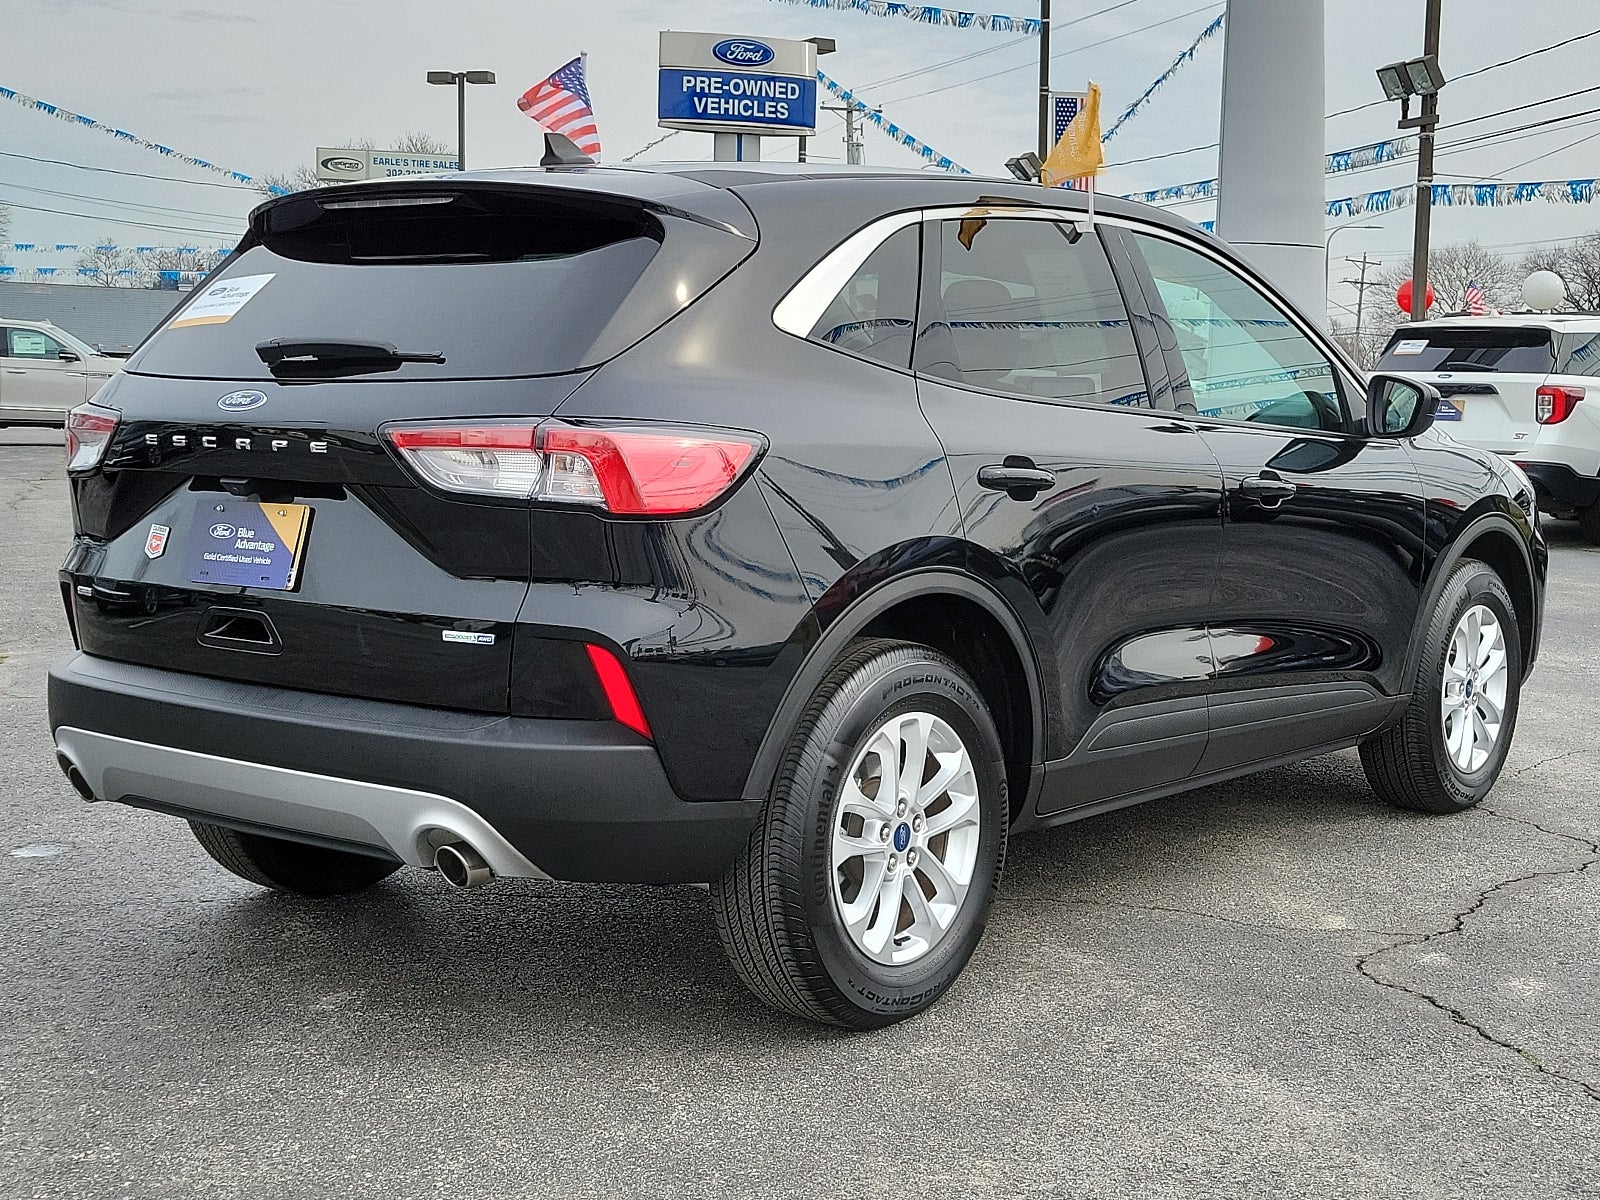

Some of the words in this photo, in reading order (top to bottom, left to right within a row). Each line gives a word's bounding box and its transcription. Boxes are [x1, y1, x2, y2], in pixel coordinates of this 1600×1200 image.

[726, 43, 763, 61] Ford
[682, 76, 800, 100] PRE-OWNED
[693, 97, 789, 119] VEHICLES
[373, 157, 409, 167] EARLE'S
[412, 159, 430, 168] TIRE
[433, 160, 460, 170] SALES
[225, 390, 261, 405] Ford
[145, 433, 328, 454] ESCAPE
[1513, 432, 1528, 440] ST
[213, 525, 232, 537] Ford
[237, 527, 255, 539] Blue
[234, 538, 275, 553] Advantage
[203, 552, 217, 561] Gold
[217, 553, 239, 563] Certified
[253, 556, 272, 565] Vehicle
